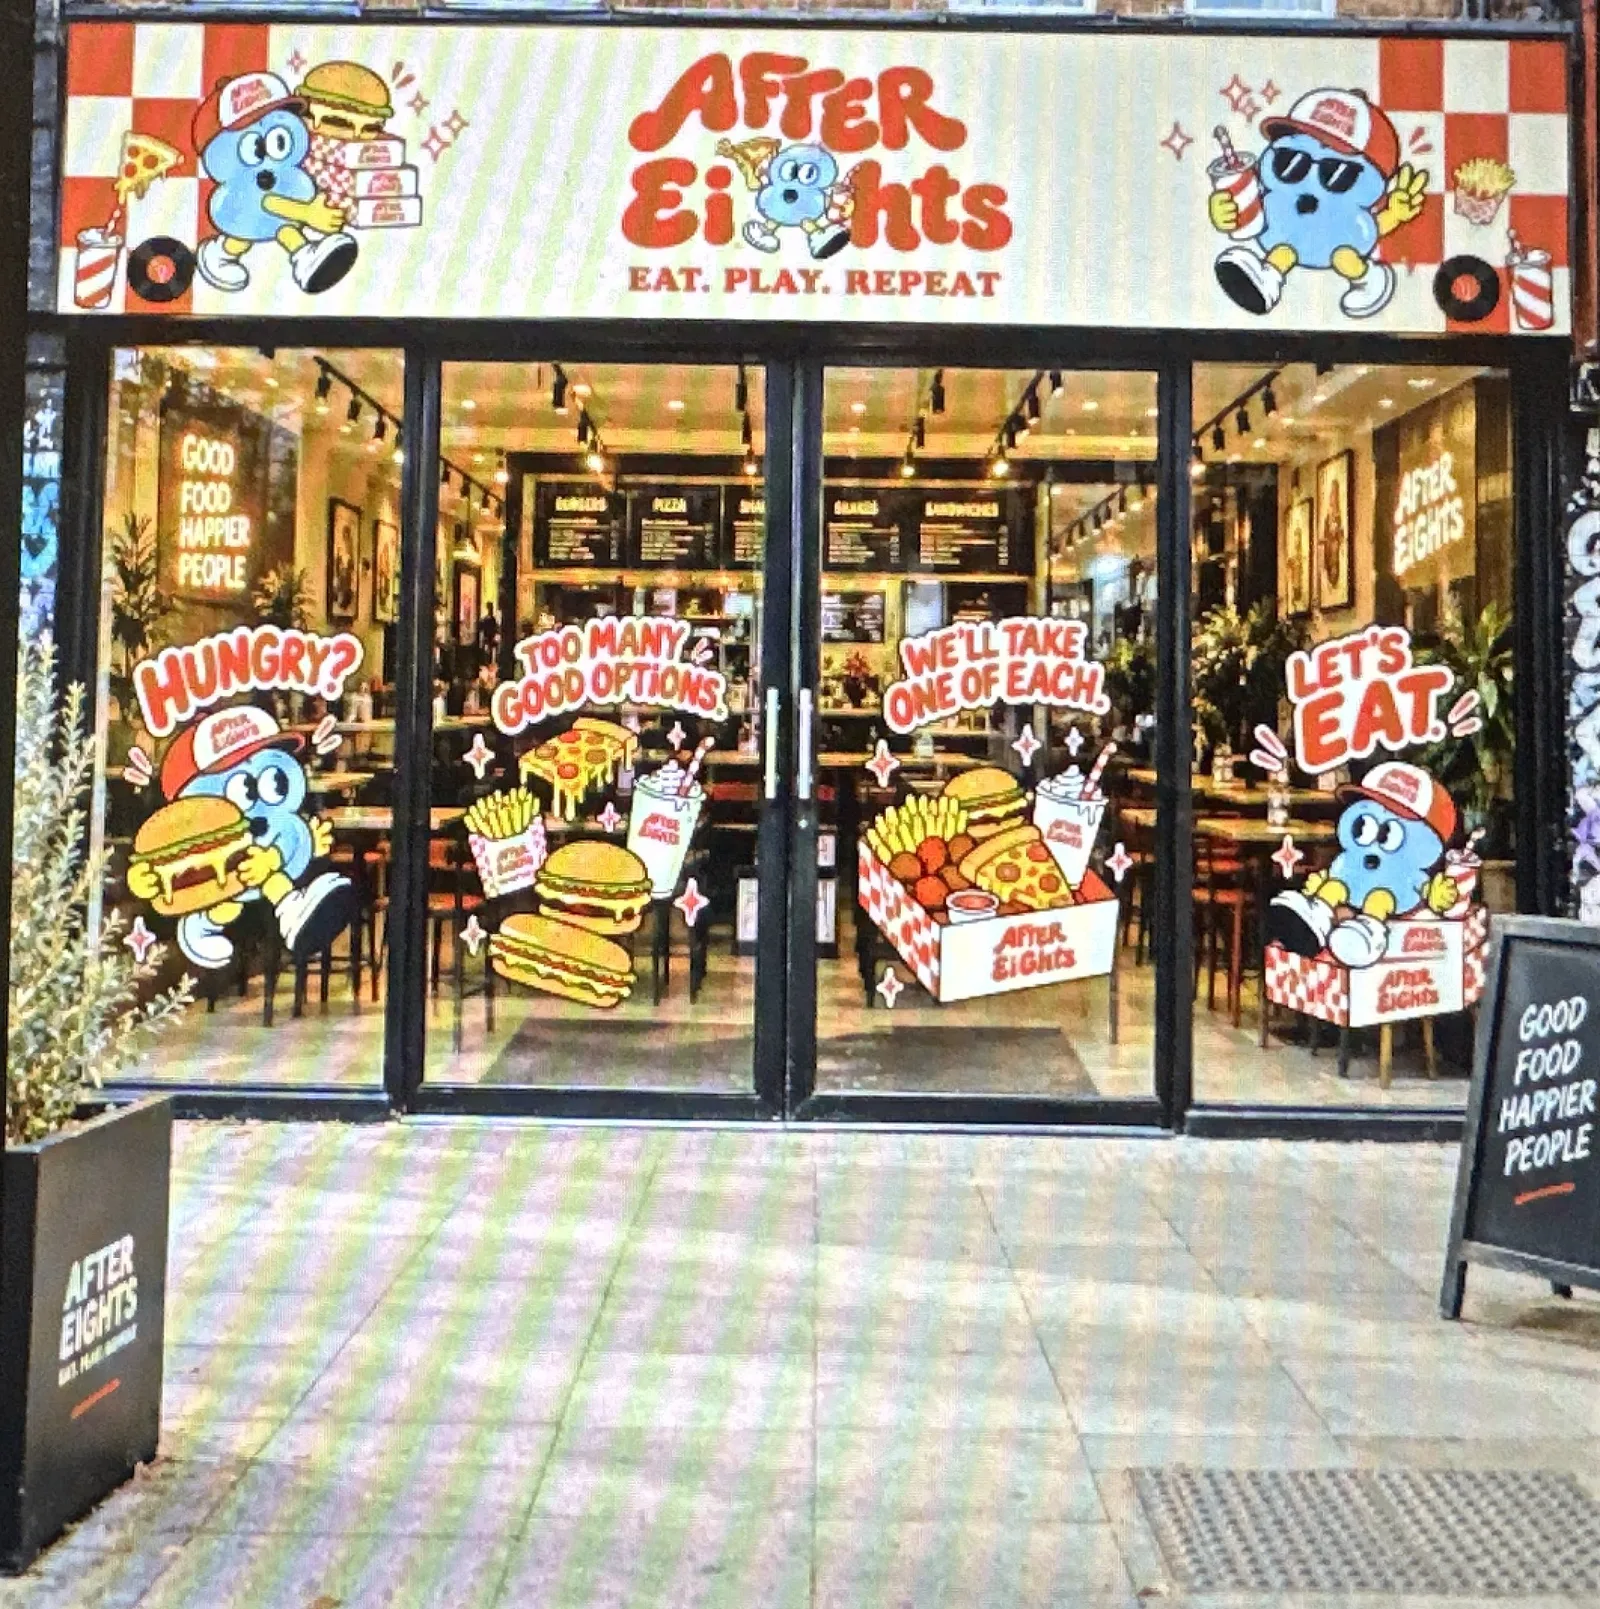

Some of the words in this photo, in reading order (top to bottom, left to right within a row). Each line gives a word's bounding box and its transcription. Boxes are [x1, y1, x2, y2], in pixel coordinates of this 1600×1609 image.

[628, 52, 968, 152] AFTER
[628, 266, 710, 294] EAT.
[724, 267, 830, 295] PLAY.
[845, 269, 1002, 297] REPEAT
[182, 433, 235, 476] GOOD
[180, 480, 232, 514] FOOD
[1394, 451, 1457, 525] AFTER
[178, 515, 251, 549] HAPPIER
[177, 552, 247, 589] PEOPLE
[521, 632, 581, 673] TOO
[589, 622, 686, 660] MANY
[905, 627, 1000, 677] WE'LL
[1002, 623, 1083, 660] TAKE
[1293, 632, 1406, 699] LET'S
[140, 631, 356, 731] HUNGRY?
[499, 667, 585, 727] GOOD
[889, 672, 957, 726] ONE
[960, 663, 1000, 701] OF
[1006, 661, 1105, 709] EACH.
[1302, 670, 1448, 767] EAT.
[993, 921, 1068, 954] AFTER
[1518, 995, 1588, 1042] GOOD
[1513, 1039, 1582, 1086] FOOD
[1498, 1078, 1598, 1133] HAPPIER
[1503, 1122, 1594, 1176] PEOPLE
[62, 1233, 134, 1312] AFTER
[59, 1275, 138, 1361] EIGHTS
